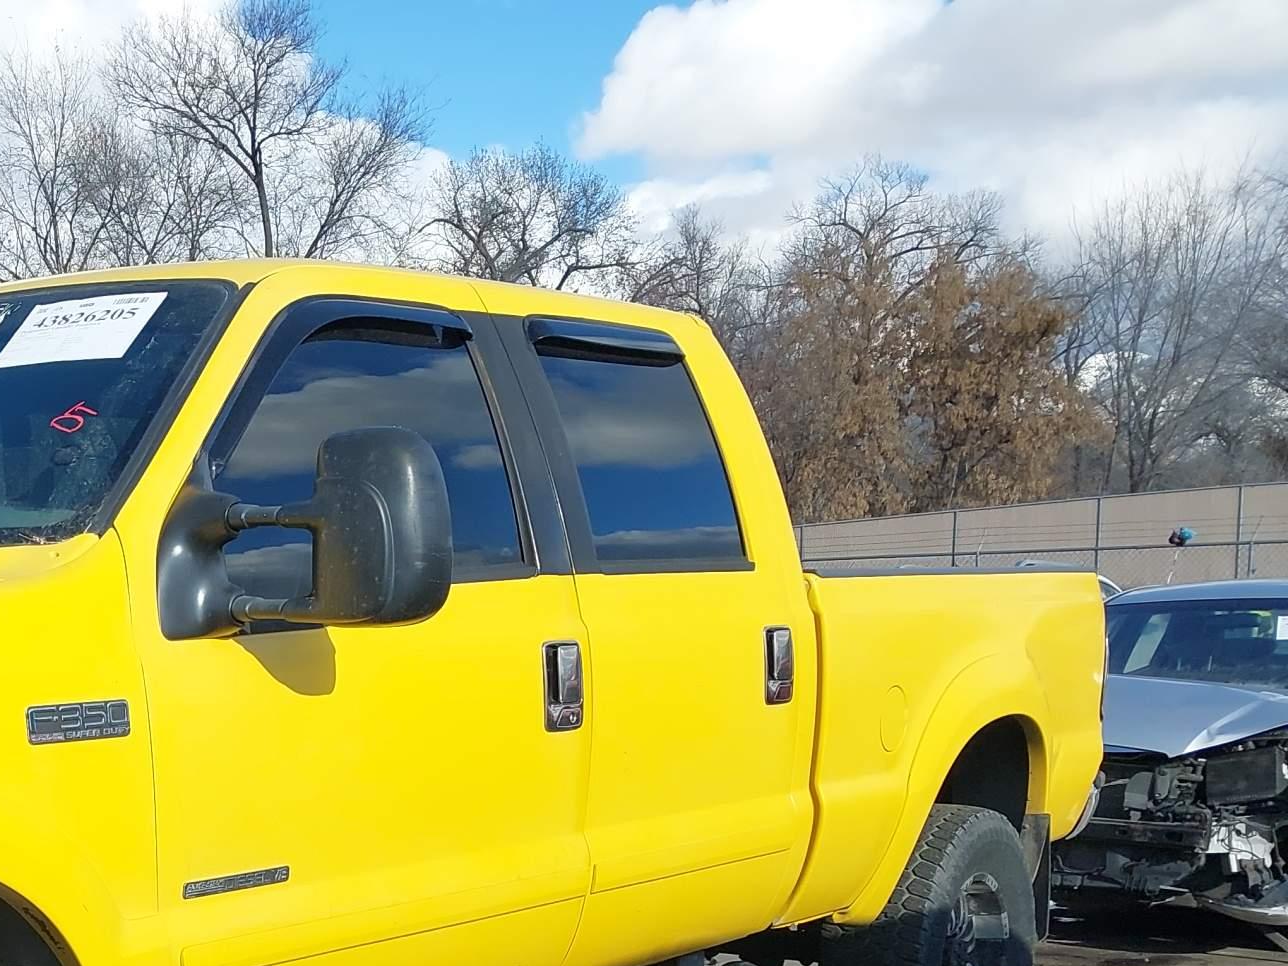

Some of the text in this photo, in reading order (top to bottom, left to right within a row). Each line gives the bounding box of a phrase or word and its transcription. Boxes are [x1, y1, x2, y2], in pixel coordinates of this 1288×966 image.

[33, 308, 140, 329] 43826205
[65, 729, 100, 739] SUPER
[103, 726, 130, 736] DUTY
